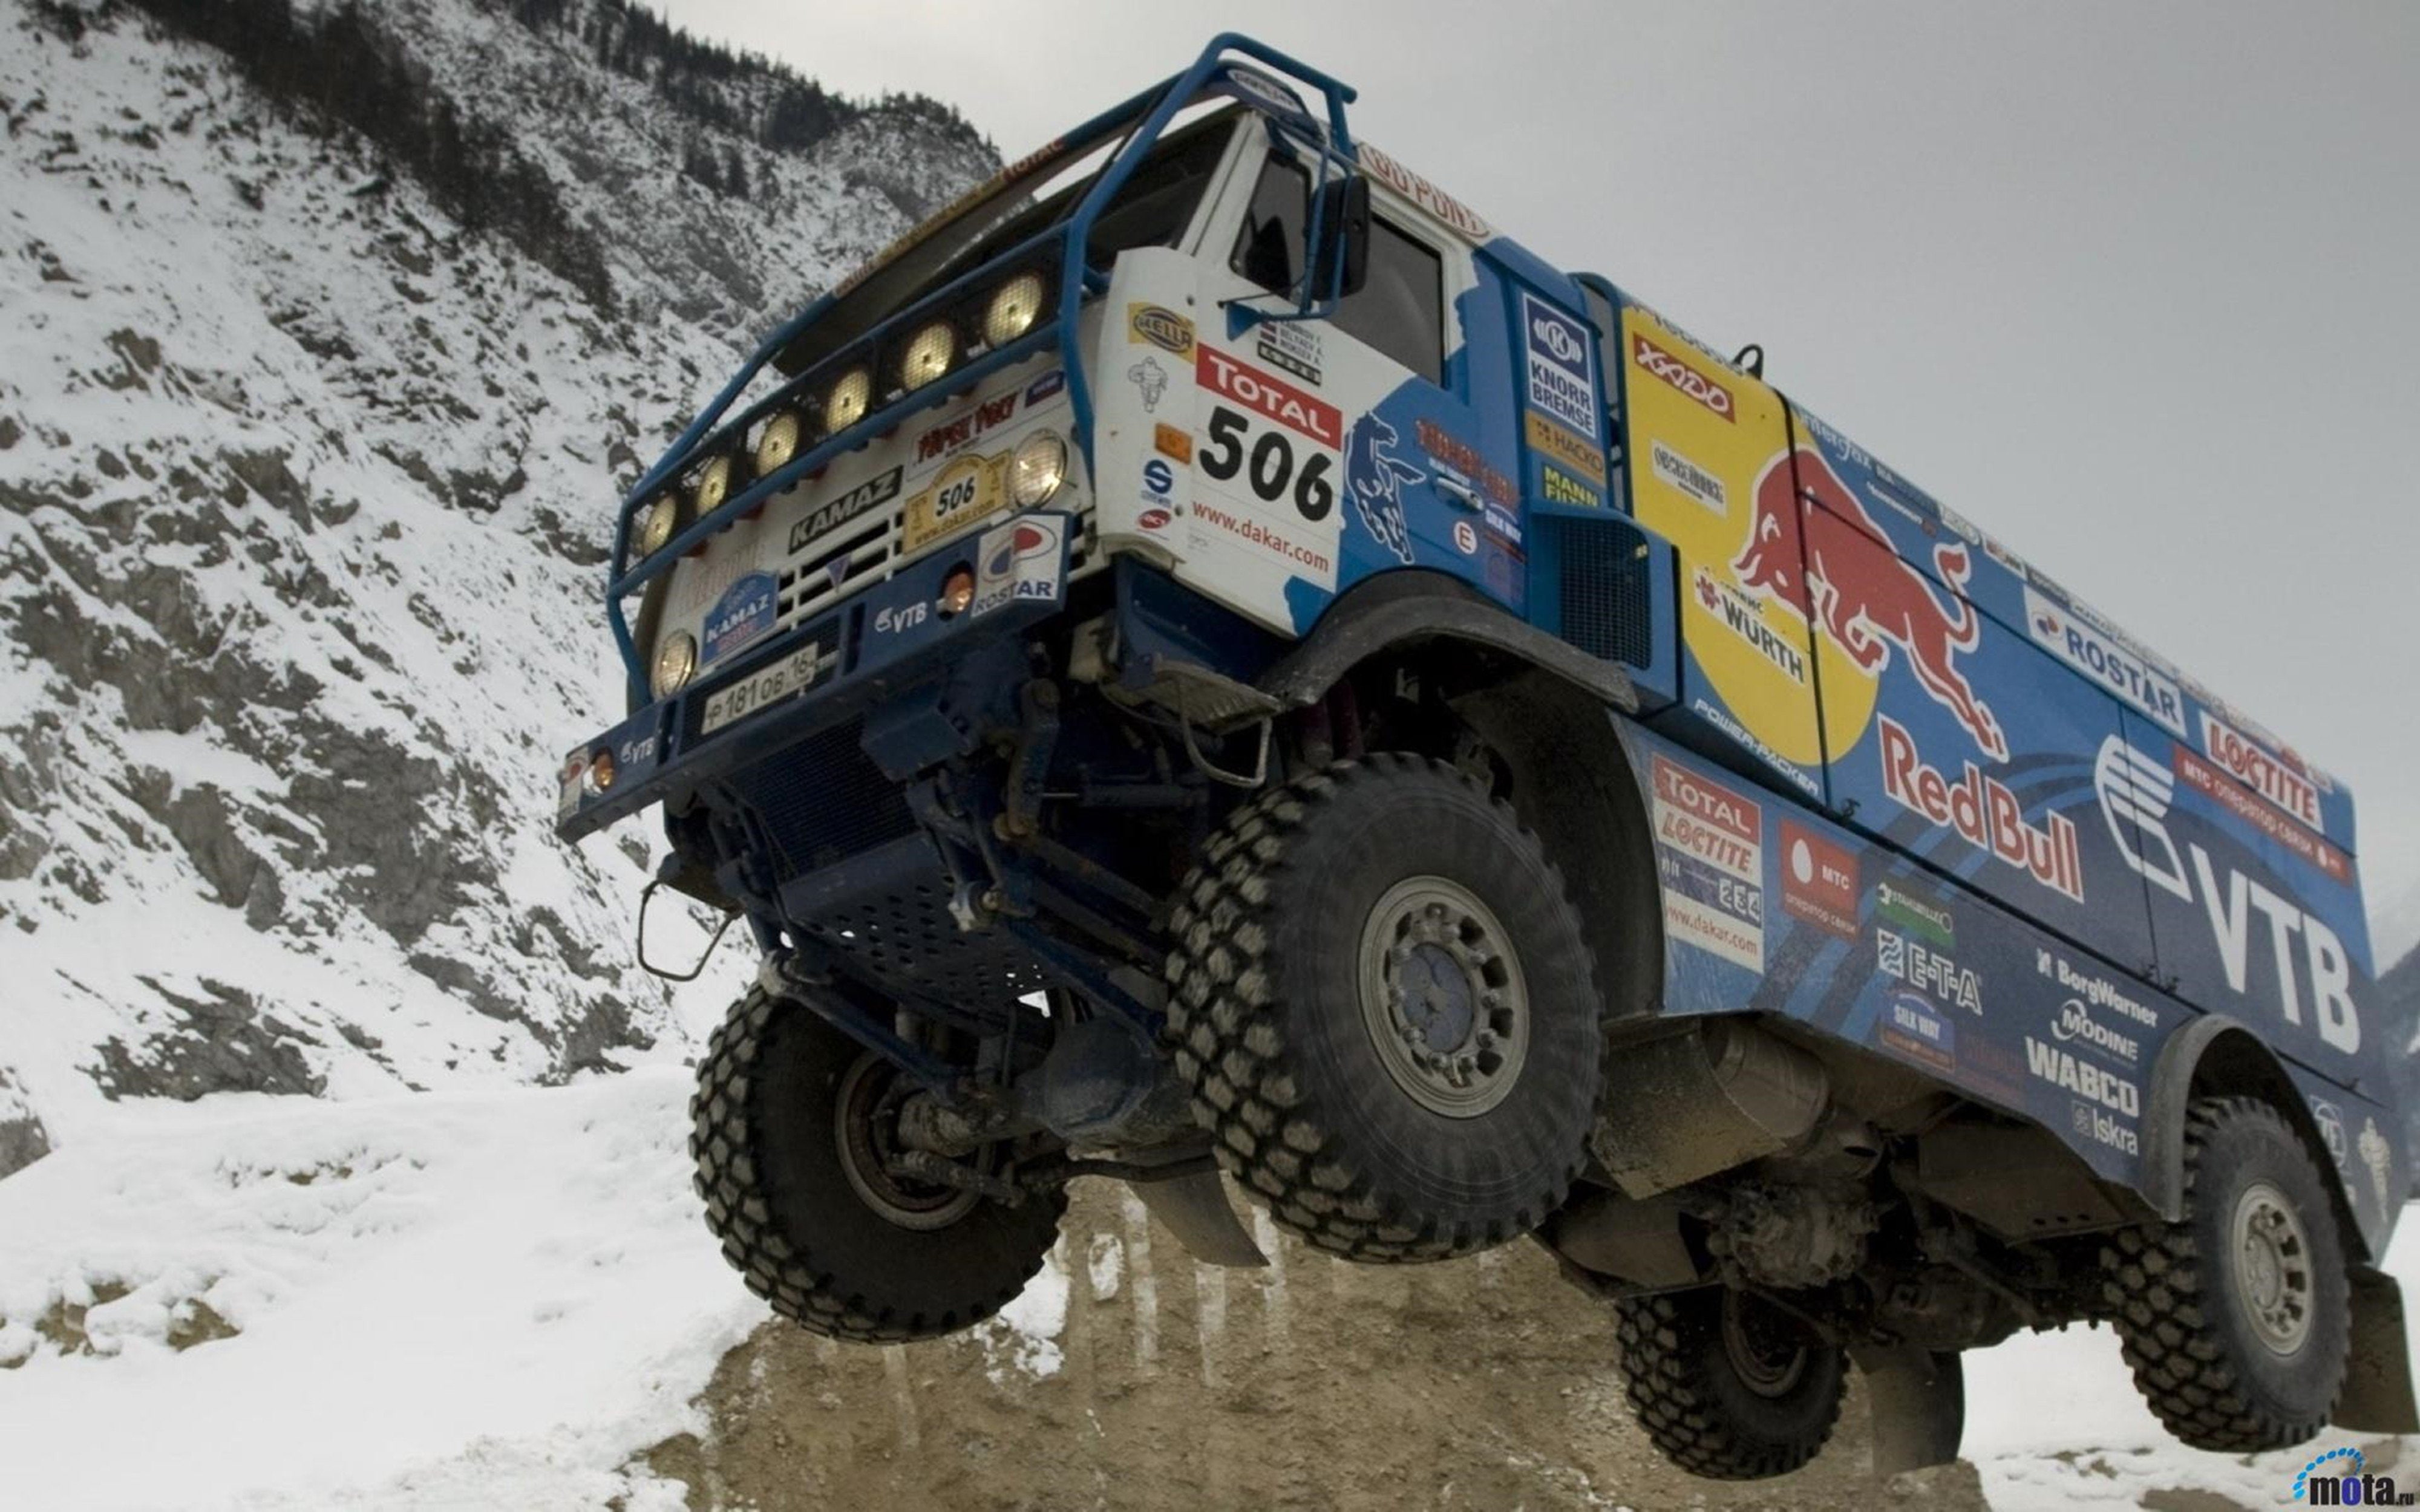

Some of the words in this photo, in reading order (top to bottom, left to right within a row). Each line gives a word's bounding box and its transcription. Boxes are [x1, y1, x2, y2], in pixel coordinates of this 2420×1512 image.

[1137, 313, 1192, 349] HELLA
[1210, 356, 1330, 438] TOTAL
[1531, 360, 1591, 411] KNORR
[1532, 383, 1594, 432] BREMSE
[1637, 341, 1729, 412] XADO
[935, 477, 975, 517] 506
[1199, 406, 1332, 521] 506
[1545, 464, 1598, 507] MANN
[792, 471, 900, 547] KAMAZ
[1192, 501, 1330, 573] www.dakar.com
[706, 593, 769, 644] KAMAZ
[974, 581, 1052, 613] ROSTAR
[2065, 625, 2178, 723] ROSTAR
[1694, 697, 1819, 795] POWER-PACKER
[2209, 723, 2316, 823] LOCTITE
[1664, 767, 1751, 834] TOTAL
[1663, 812, 1753, 872] LOCTITE
[2189, 841, 2360, 1055] VTB
[2058, 959, 2159, 1028] BorgWarner
[2061, 1008, 2138, 1061] MODINE
[2024, 1035, 2139, 1118] WABCO
[2092, 1107, 2139, 1156] Iskra
